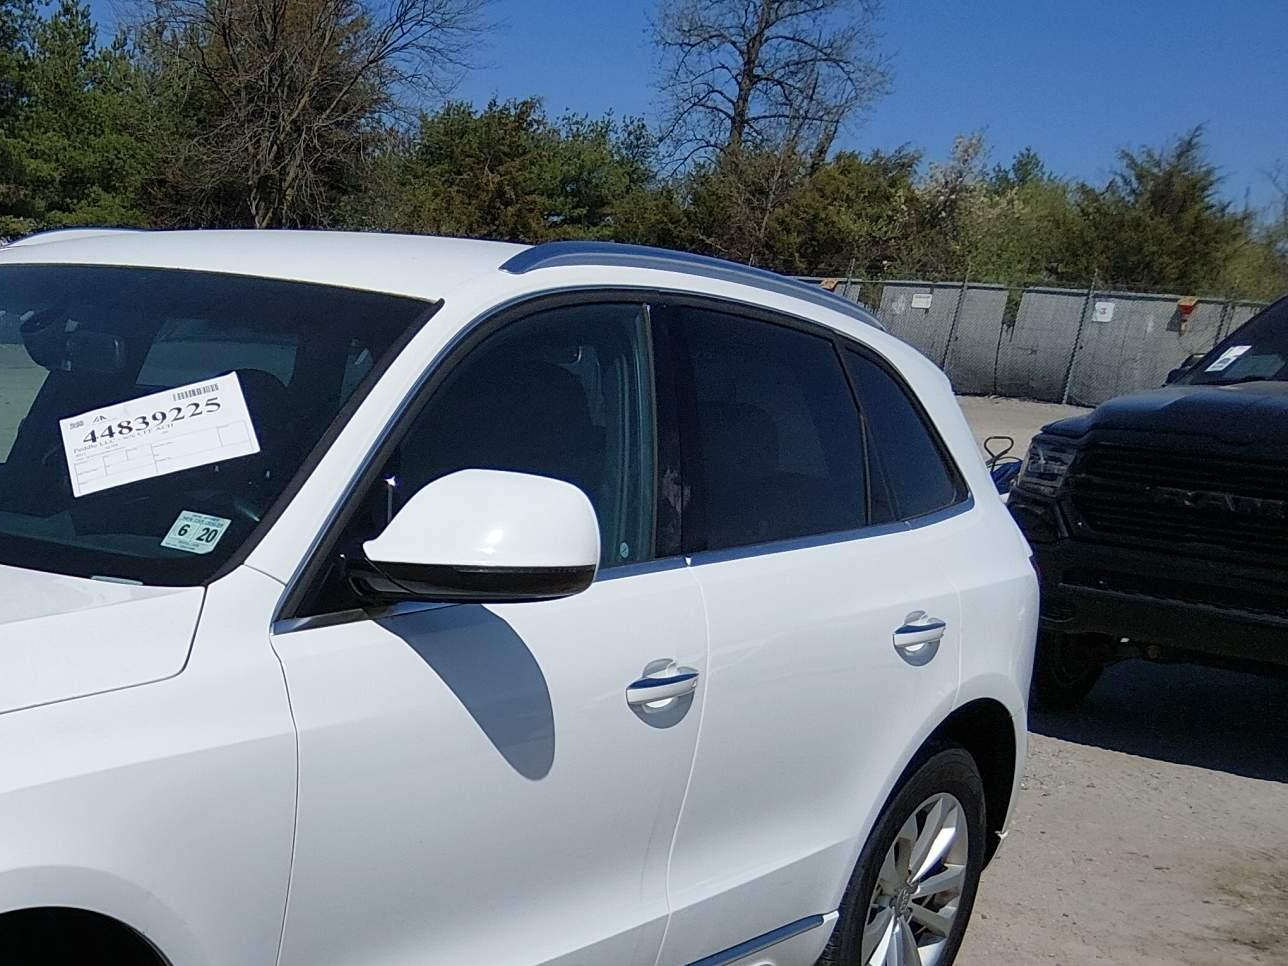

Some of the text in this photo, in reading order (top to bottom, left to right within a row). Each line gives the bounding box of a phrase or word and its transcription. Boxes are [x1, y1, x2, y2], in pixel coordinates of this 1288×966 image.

[83, 396, 222, 444] 44839225
[177, 523, 219, 544] 6 20
